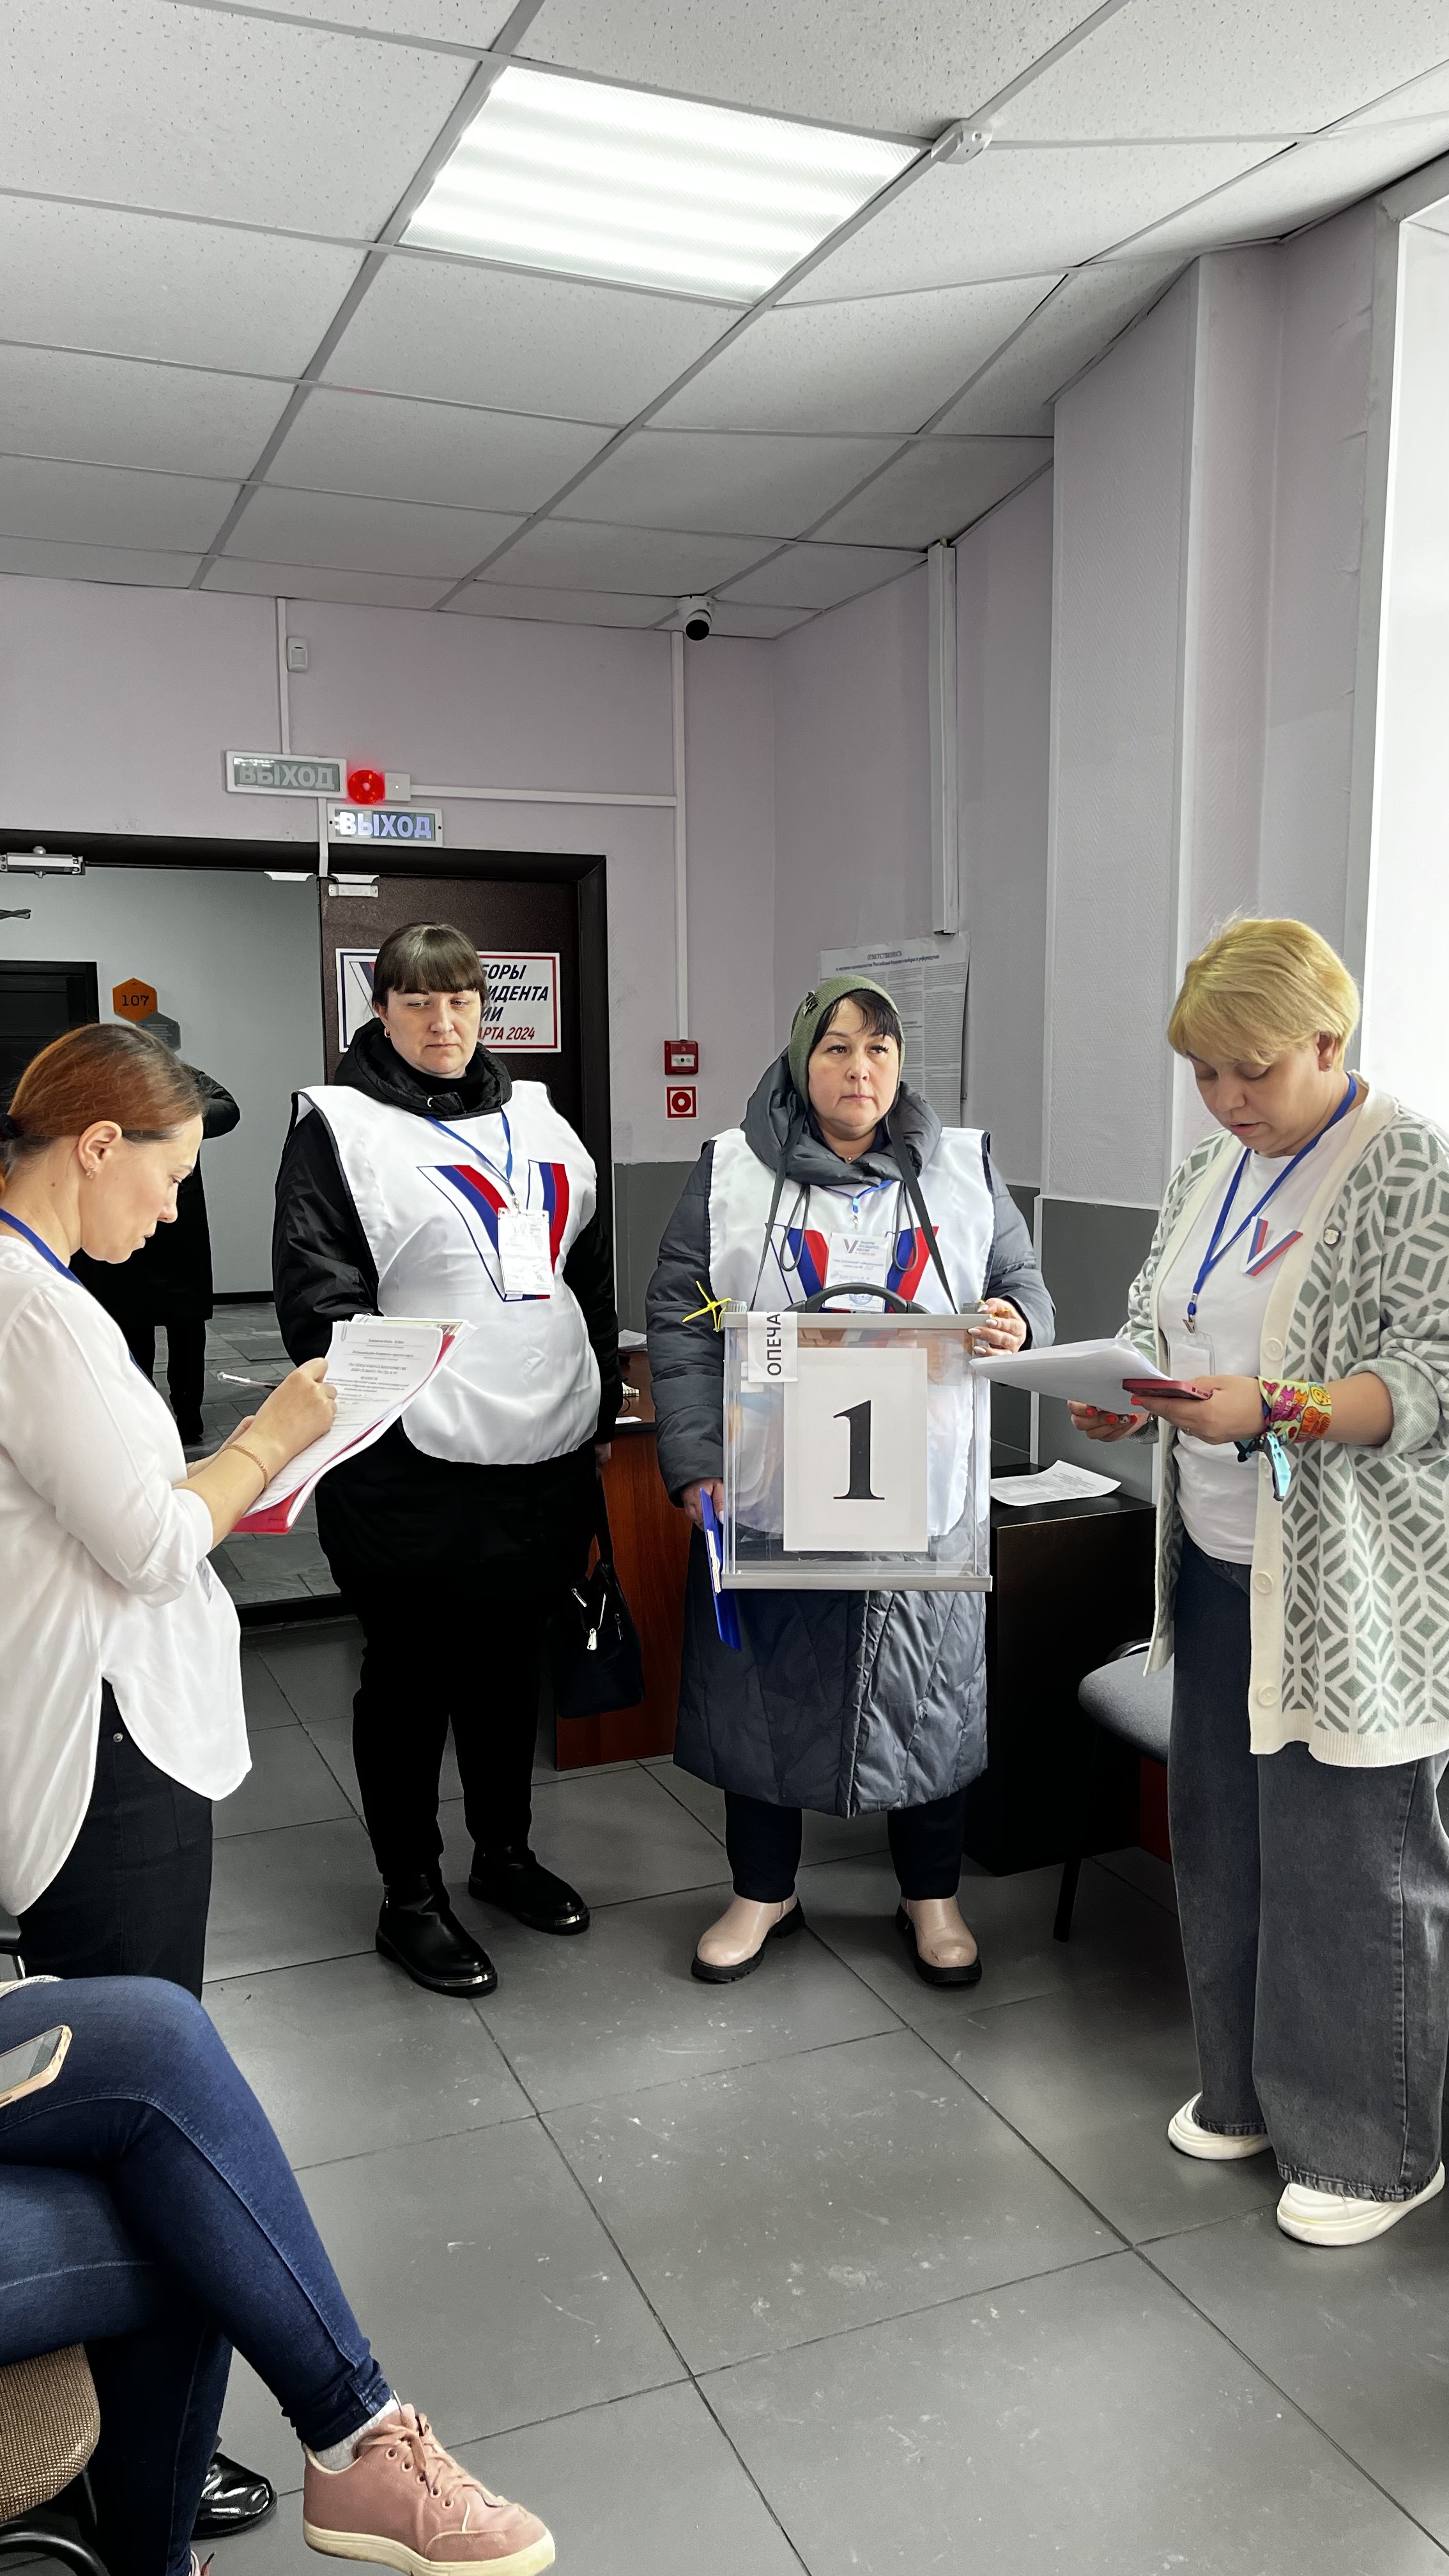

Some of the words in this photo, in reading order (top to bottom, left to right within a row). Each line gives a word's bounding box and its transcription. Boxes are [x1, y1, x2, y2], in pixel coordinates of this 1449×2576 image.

[239, 765, 335, 790] ВЫХОД
[339, 811, 432, 839] ВЫХОД
[122, 995, 150, 1006] 107
[488, 985, 549, 1003] ИДЕНТА
[478, 1027, 505, 1040] АРТА
[506, 1027, 535, 1041] 2024
[766, 1312, 782, 1376] ОПЕЧА
[832, 1400, 885, 1500] 1
